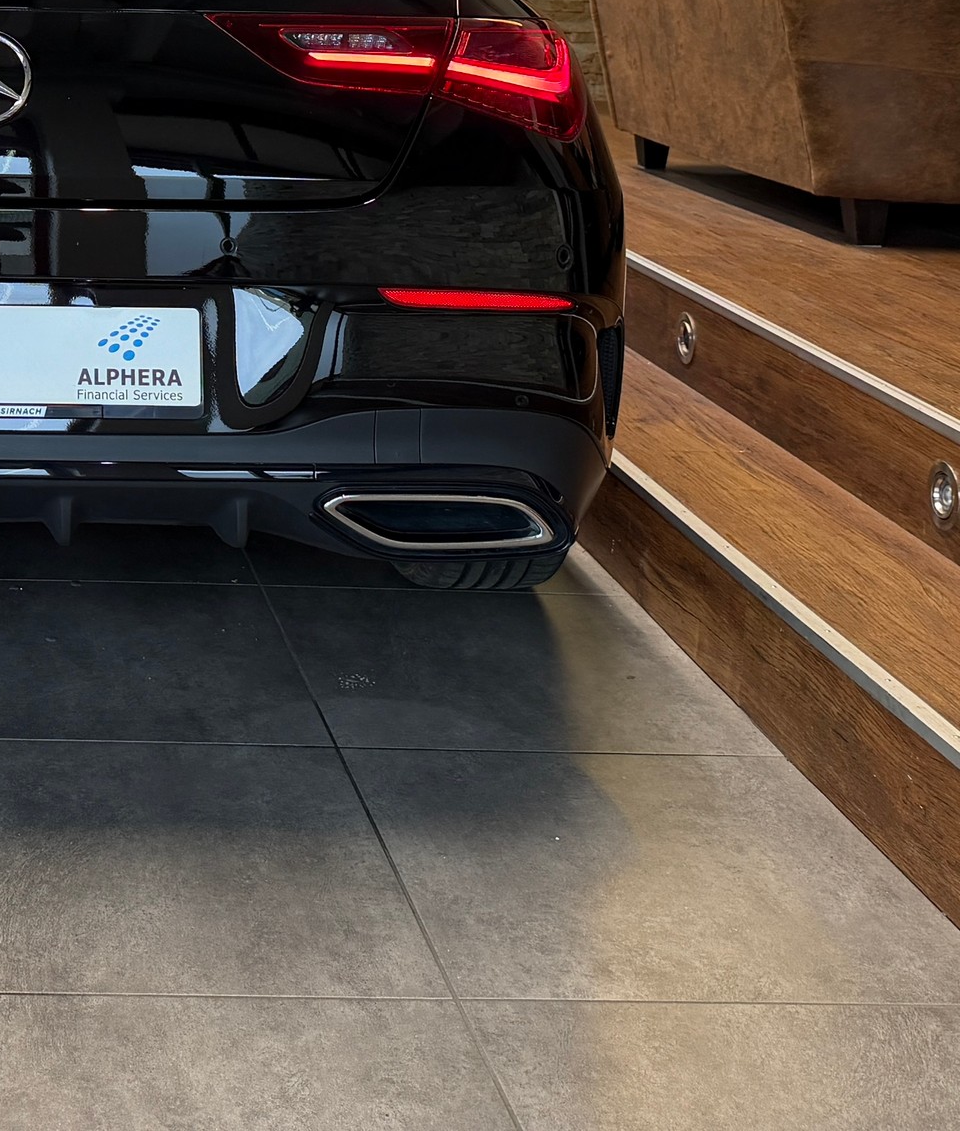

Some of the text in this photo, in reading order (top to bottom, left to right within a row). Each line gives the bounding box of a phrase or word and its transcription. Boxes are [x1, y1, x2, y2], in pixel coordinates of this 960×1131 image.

[77, 367, 183, 387] ALPHERA
[77, 389, 183, 401] Financial Services
[0, 407, 42, 415] SIRNACH
